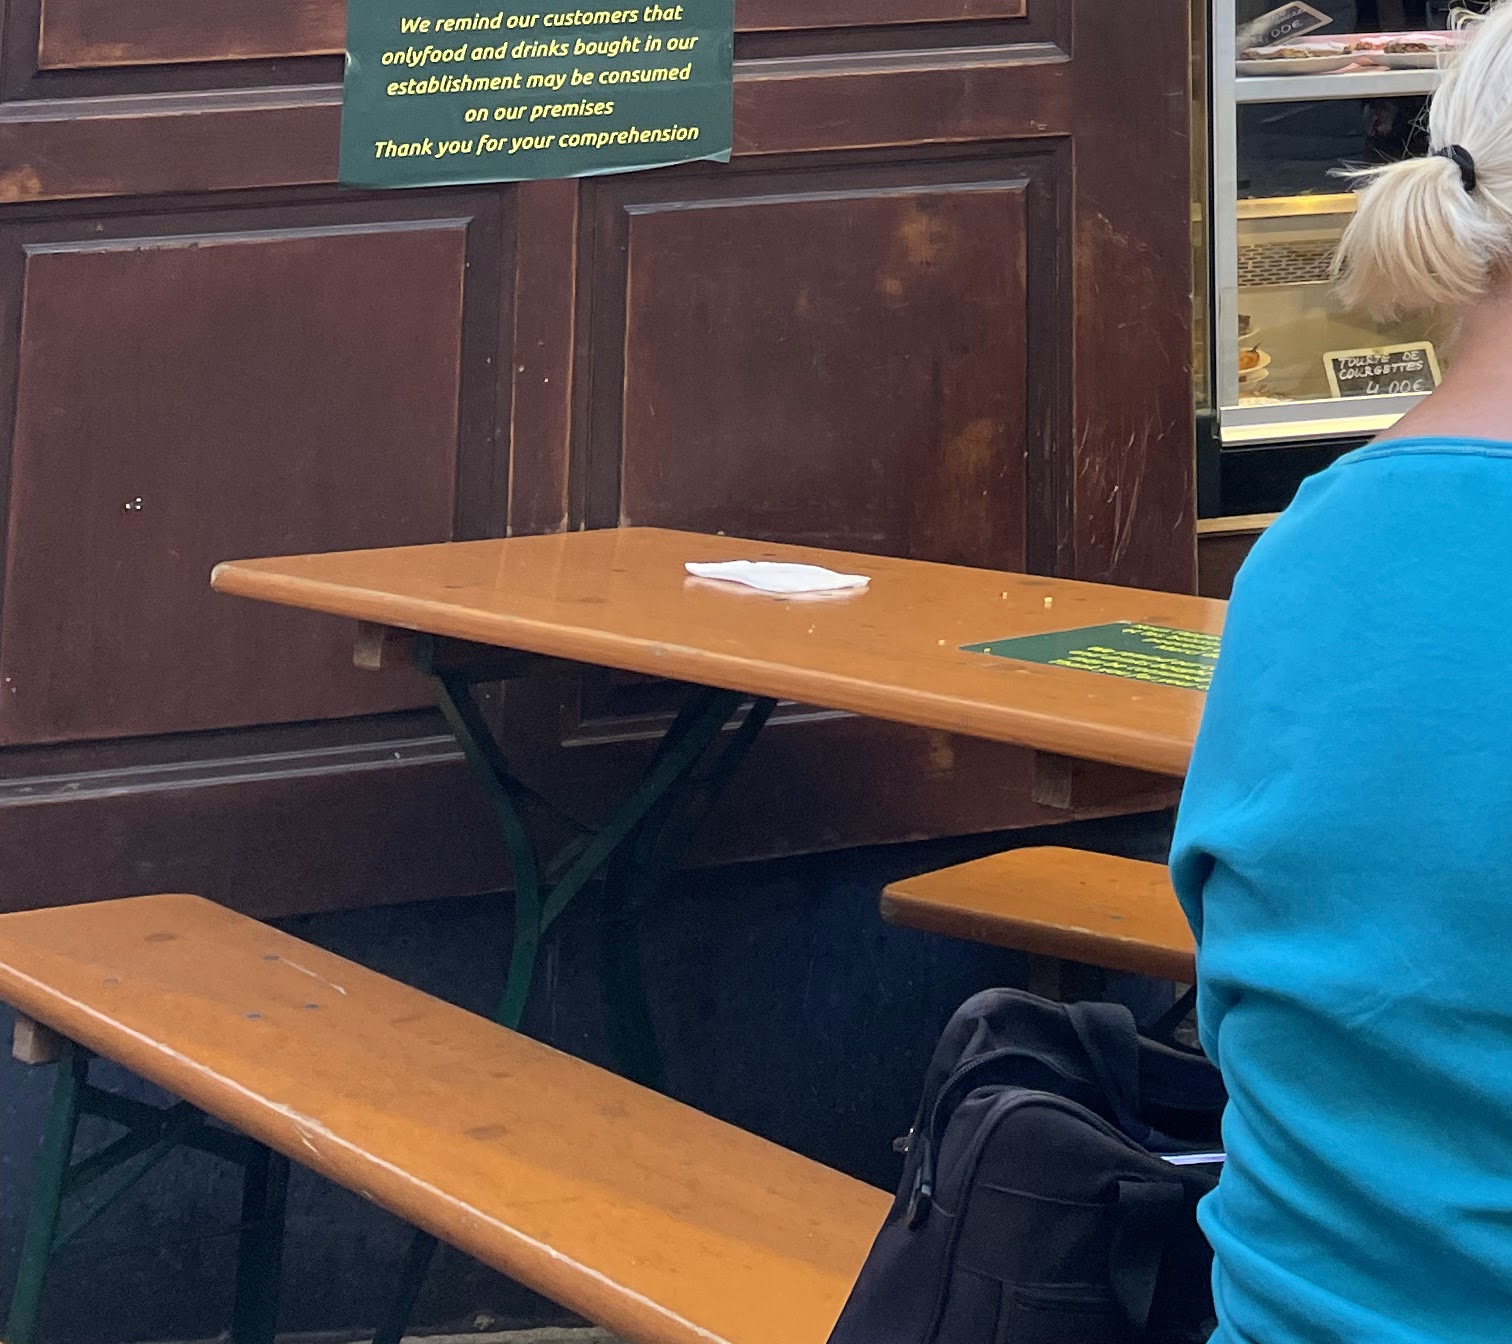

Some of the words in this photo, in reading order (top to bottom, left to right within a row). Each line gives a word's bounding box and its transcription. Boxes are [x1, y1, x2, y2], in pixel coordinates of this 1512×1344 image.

[401, 16, 430, 34] We
[435, 12, 503, 32] remind
[507, 15, 539, 29] our
[543, 8, 639, 27] customers
[643, 5, 683, 23] that
[471, 42, 508, 61] and
[511, 38, 569, 58] drinks
[573, 37, 641, 58] bought
[645, 35, 662, 52] in
[667, 34, 698, 51] our
[387, 74, 522, 97] establishment
[526, 73, 567, 92] may
[571, 68, 594, 86] be
[598, 63, 692, 84] consumed
[465, 108, 488, 123] on
[494, 106, 527, 121] our
[529, 99, 614, 122] premises
[375, 139, 433, 159] Thank
[435, 140, 474, 158] you
[477, 135, 508, 155] for
[511, 134, 556, 153] your
[558, 125, 700, 151] comprehension
[1340, 360, 1424, 380] COURGETTES
